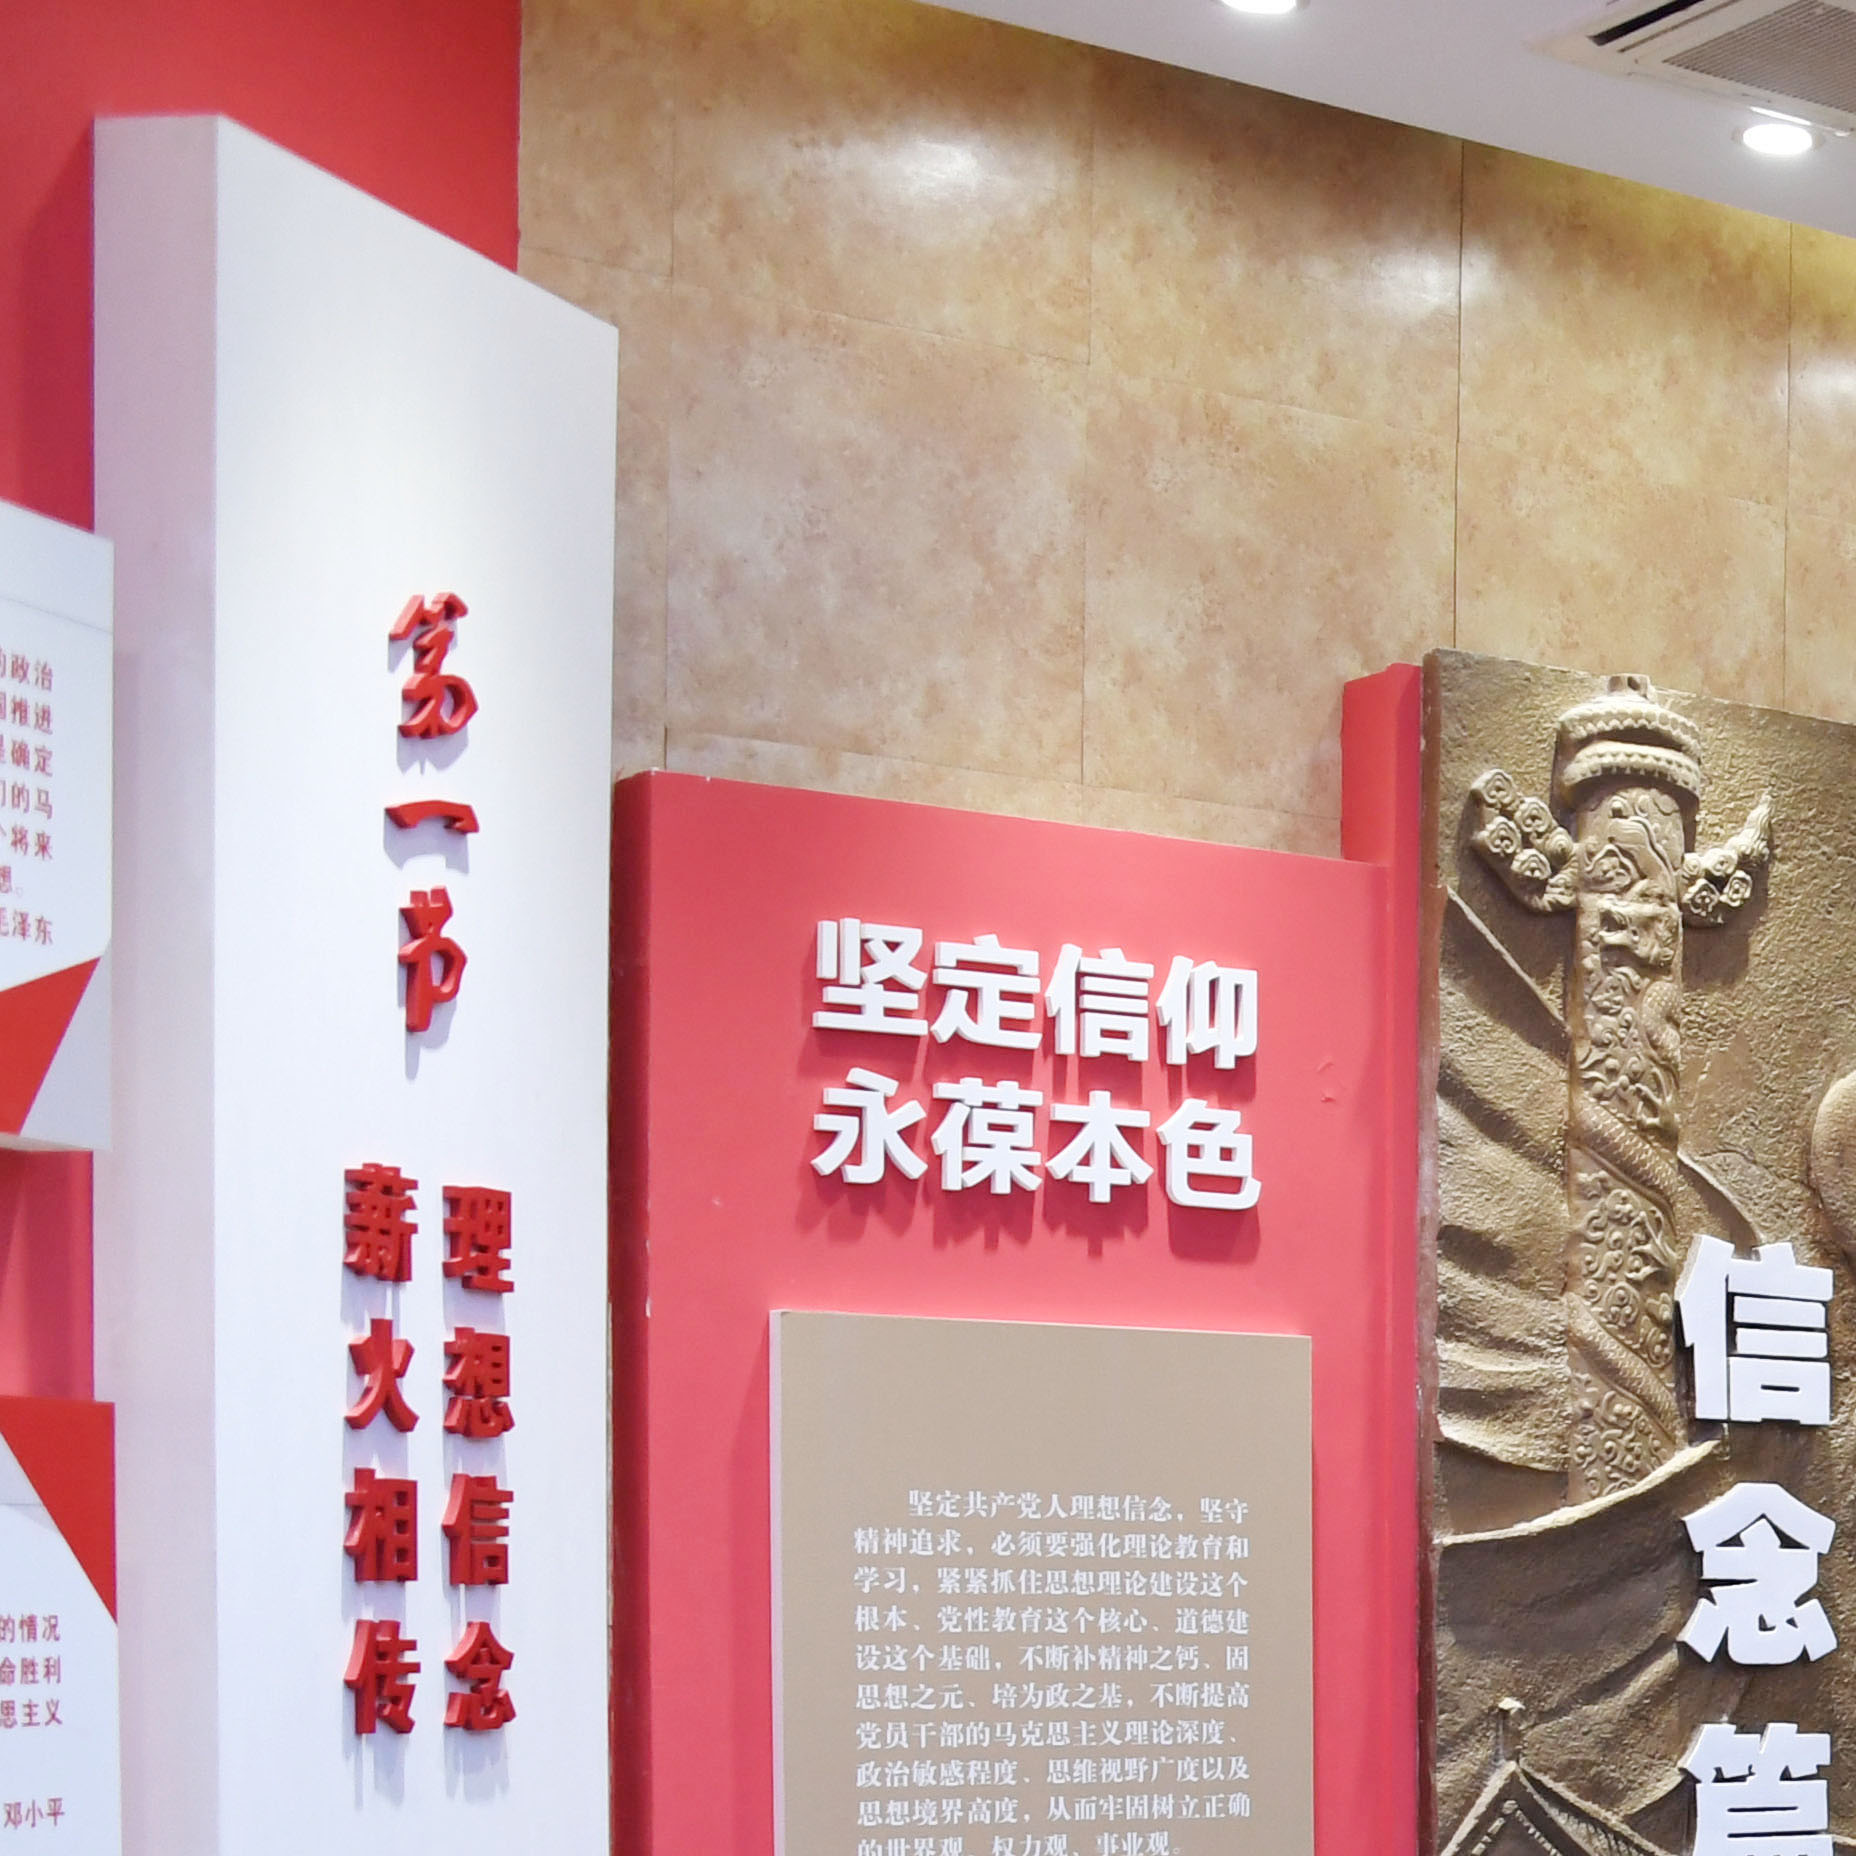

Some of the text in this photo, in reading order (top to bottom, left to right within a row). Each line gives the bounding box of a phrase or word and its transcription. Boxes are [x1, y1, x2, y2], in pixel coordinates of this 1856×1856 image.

[0, 734, 53, 777] 确定
[0, 779, 53, 821] 的马
[384, 592, 480, 1032] 第一节
[812, 918, 1259, 1070] 坚定信仰
[812, 1067, 1262, 1210] 永葆本色
[343, 1162, 421, 1735] 薪火相传
[443, 1185, 516, 1732] 理想信念
[908, 1490, 1249, 1525] 坚定共产党人理想信念，坚守
[854, 1527, 1250, 1561] 精神追求，必须要强化理论教育和
[854, 1566, 1249, 1598] 学习，紧紧抓住思想理论建设这个
[0, 1614, 61, 1643] 的情况
[854, 1604, 1250, 1635] 根本、党性教育这个核心、道德建
[0, 1656, 62, 1686] 命胜利
[855, 1644, 1250, 1672] 设这个基础，不断补精神之钙、固
[856, 1681, 1251, 1710] 思想之元、培为政之基，不断提高
[0, 1698, 63, 1729] 思主义
[856, 1719, 1237, 1750] 党员干部的马克思主义理论深度、
[856, 1756, 1251, 1788] 政治敏感程度、思维视野广度以及
[4, 1798, 65, 1830] 邓小平
[857, 1792, 1252, 1827] 思想境界高度，从而牢固树立正确
